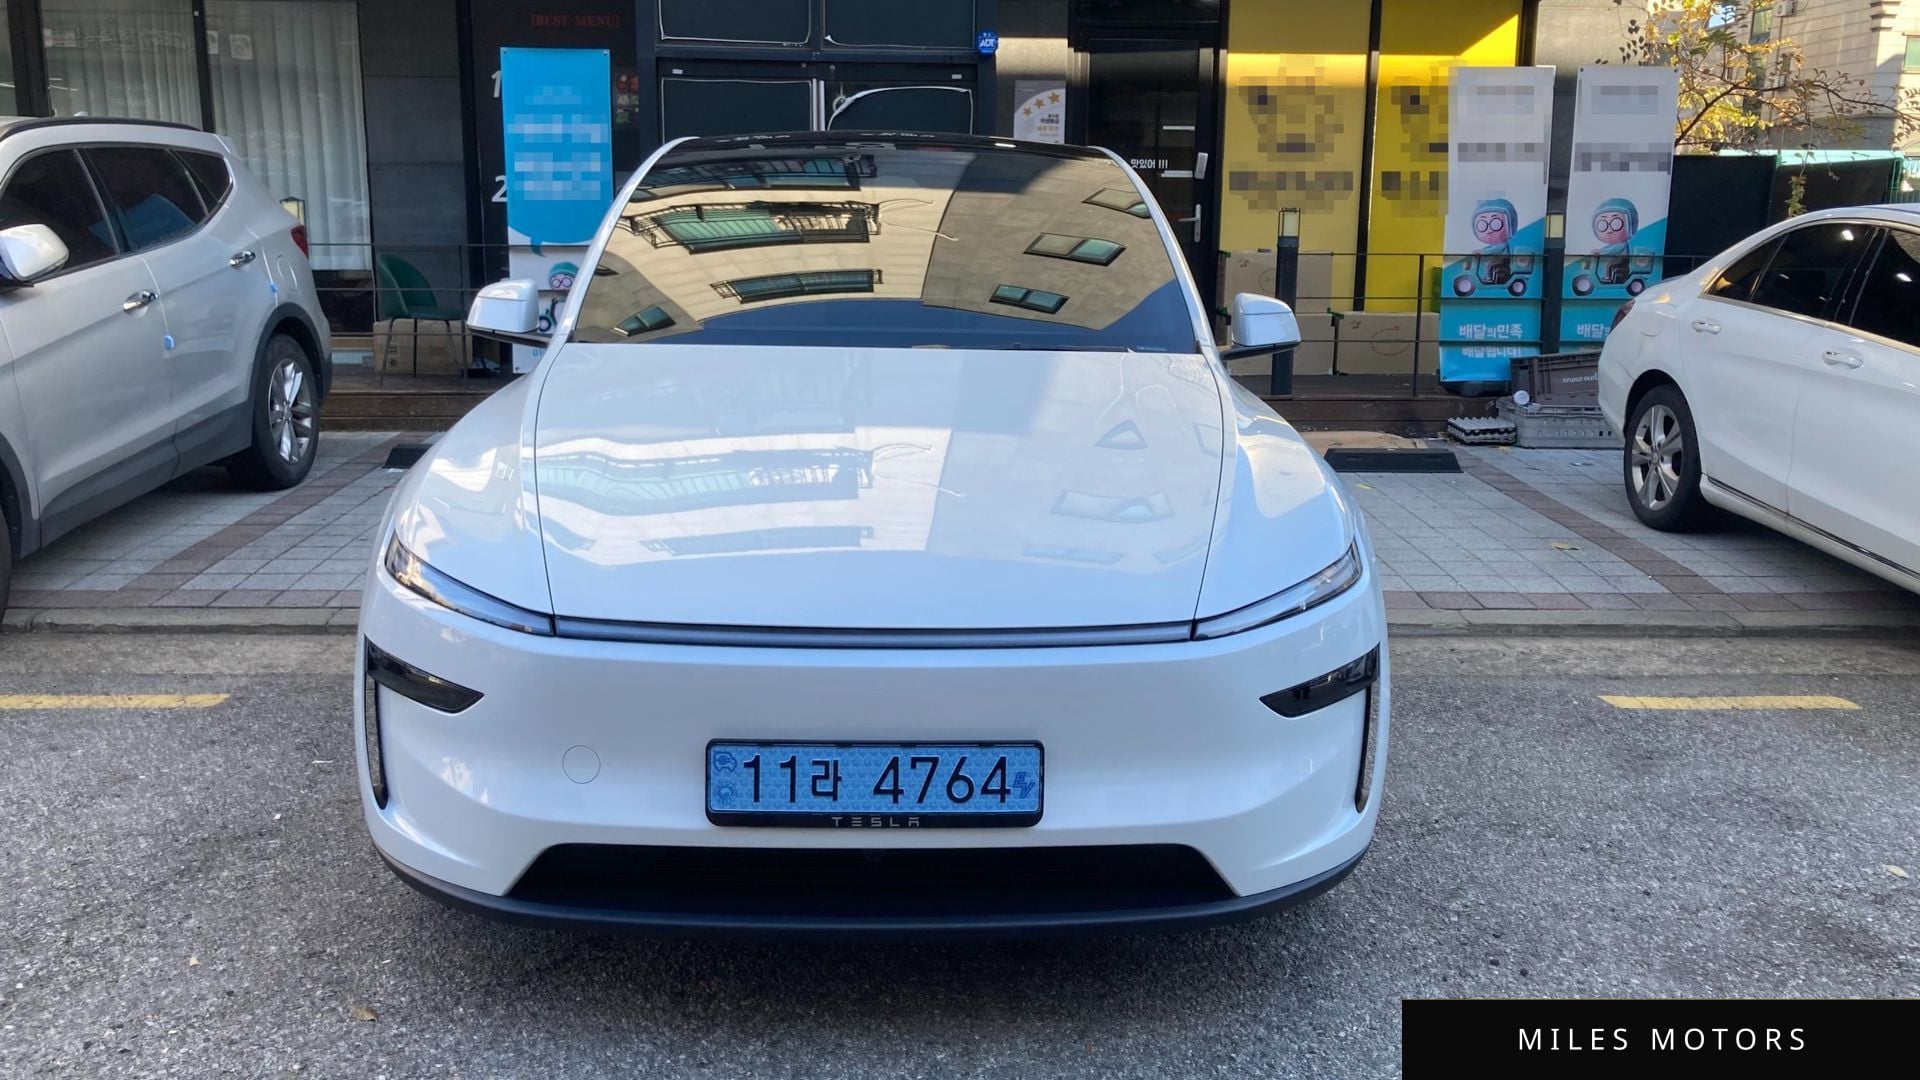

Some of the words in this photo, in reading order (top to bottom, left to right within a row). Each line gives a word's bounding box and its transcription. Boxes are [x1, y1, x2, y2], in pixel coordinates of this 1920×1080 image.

[531, 14, 568, 26] [BEST
[979, 38, 995, 48] ADT
[1130, 158, 1156, 169] 맛있어
[1459, 324, 1523, 339] 배달의민족
[743, 755, 842, 803] 11라
[872, 755, 1011, 803] 4764
[831, 816, 920, 827] TESLA
